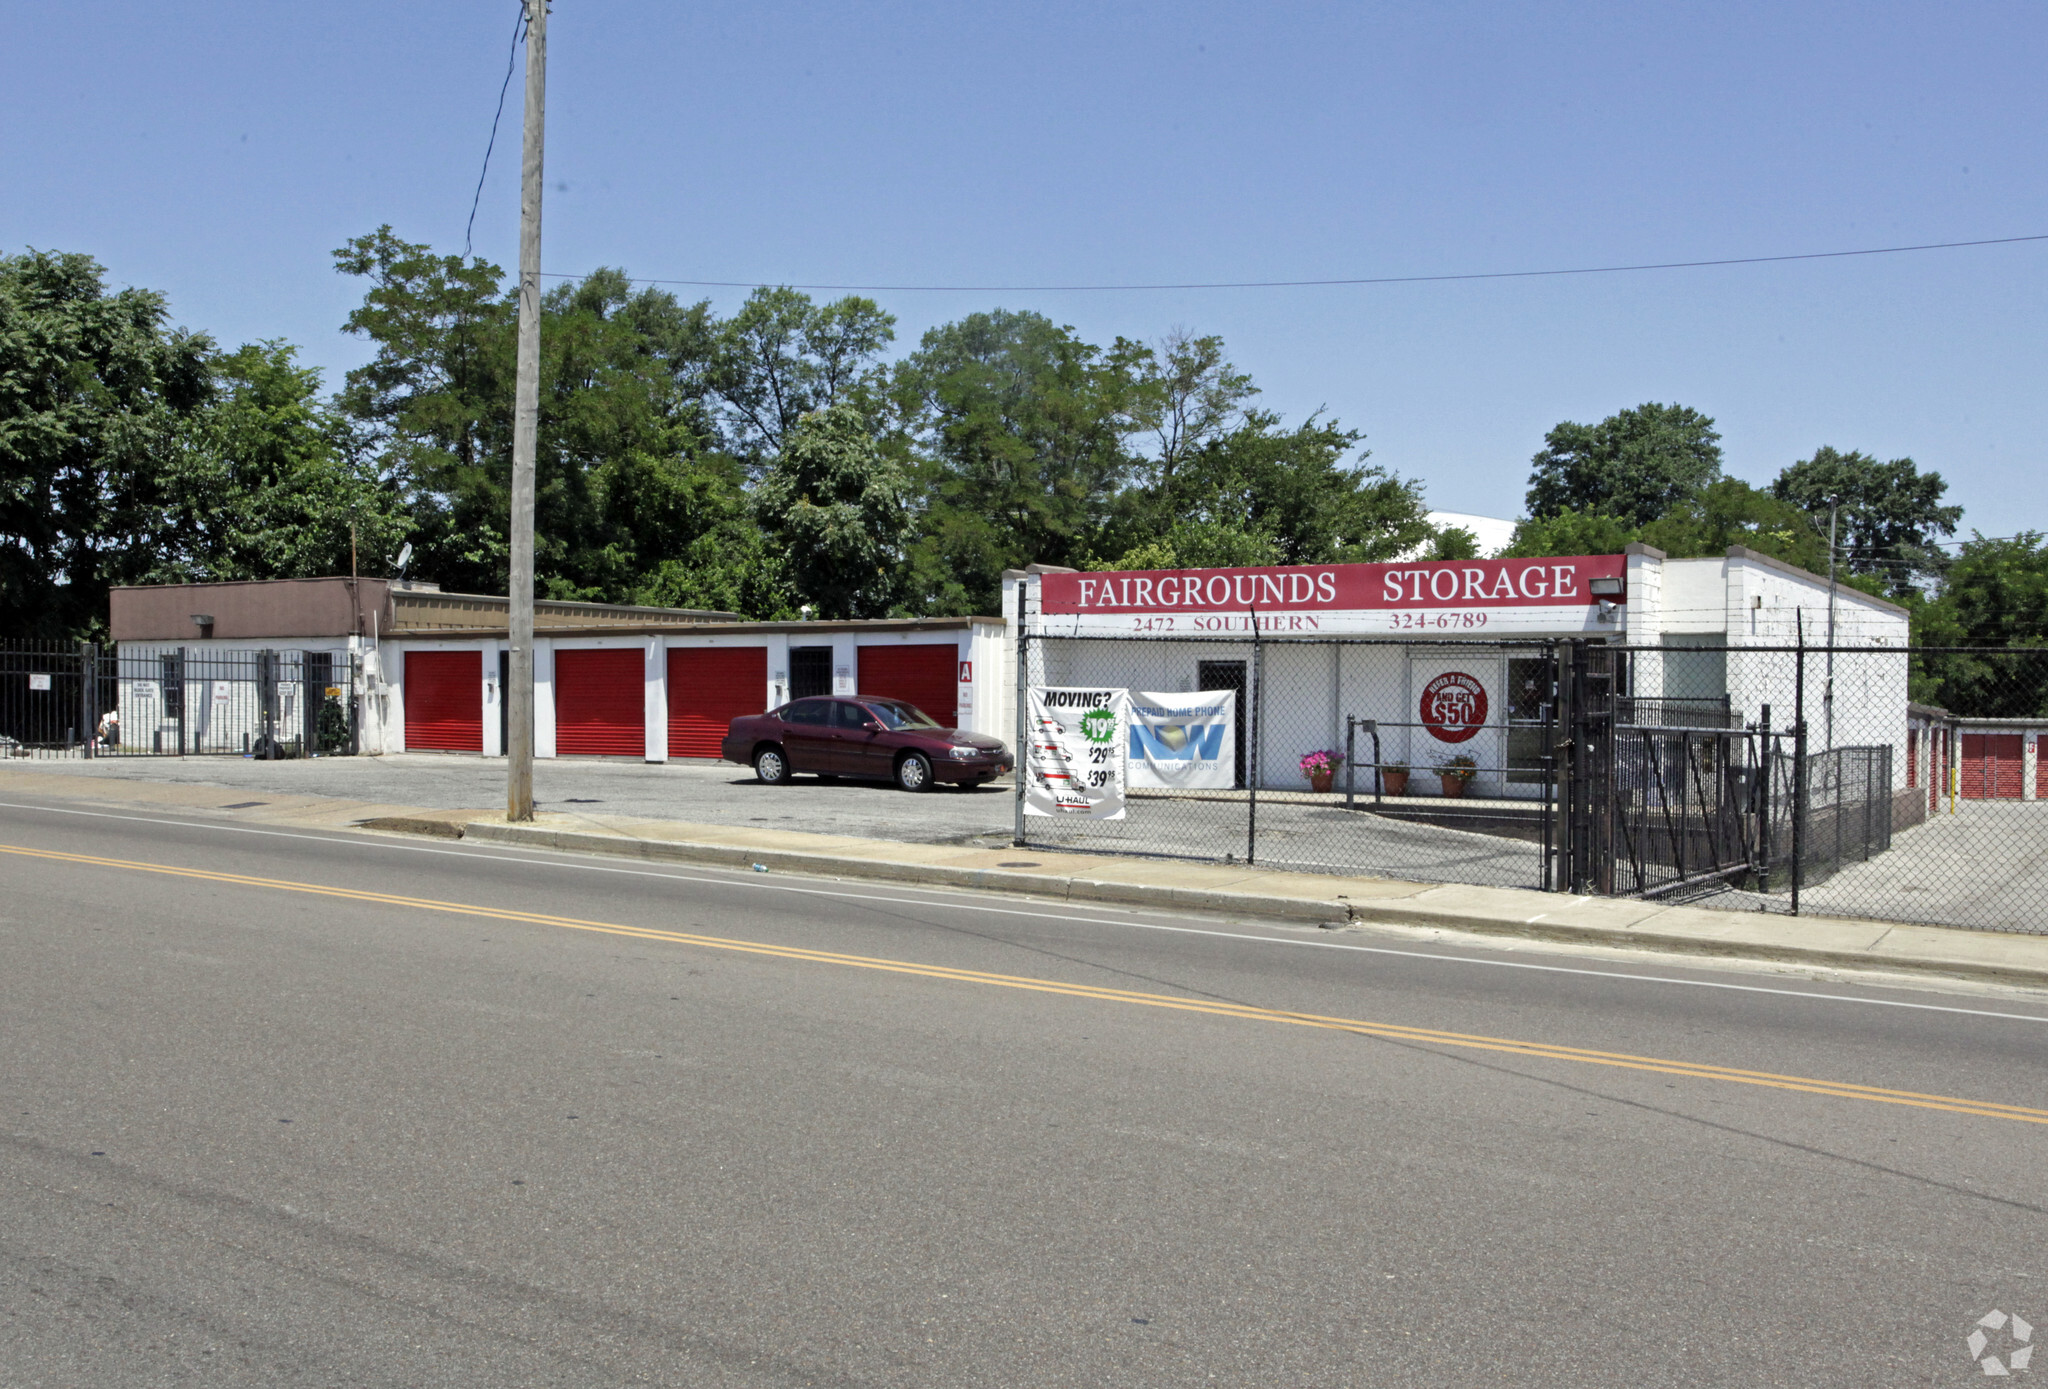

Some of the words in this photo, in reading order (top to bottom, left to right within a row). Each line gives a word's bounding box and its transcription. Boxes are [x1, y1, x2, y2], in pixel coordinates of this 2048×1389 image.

[1078, 572, 1337, 608] FAIRGROUNDS
[1382, 565, 1577, 602] STORAGE
[1133, 617, 1175, 633] 2472
[1193, 615, 1321, 632] SOUTHERN
[1389, 612, 1488, 630] 324-6789
[961, 664, 971, 680] A
[1428, 675, 1449, 694] REFER
[1457, 676, 1481, 694] FRIEND
[1043, 691, 1112, 708] MOVING?
[1436, 693, 1454, 702] AND
[1456, 693, 1470, 703] GET
[1131, 706, 1165, 717] PREPAID
[1167, 706, 1192, 717] HOME
[1194, 706, 1226, 717] PHONE
[1435, 702, 1473, 725] $50
[1128, 761, 1218, 771] COMMUNICATIONS
[1056, 796, 1089, 805] U-HAUL
